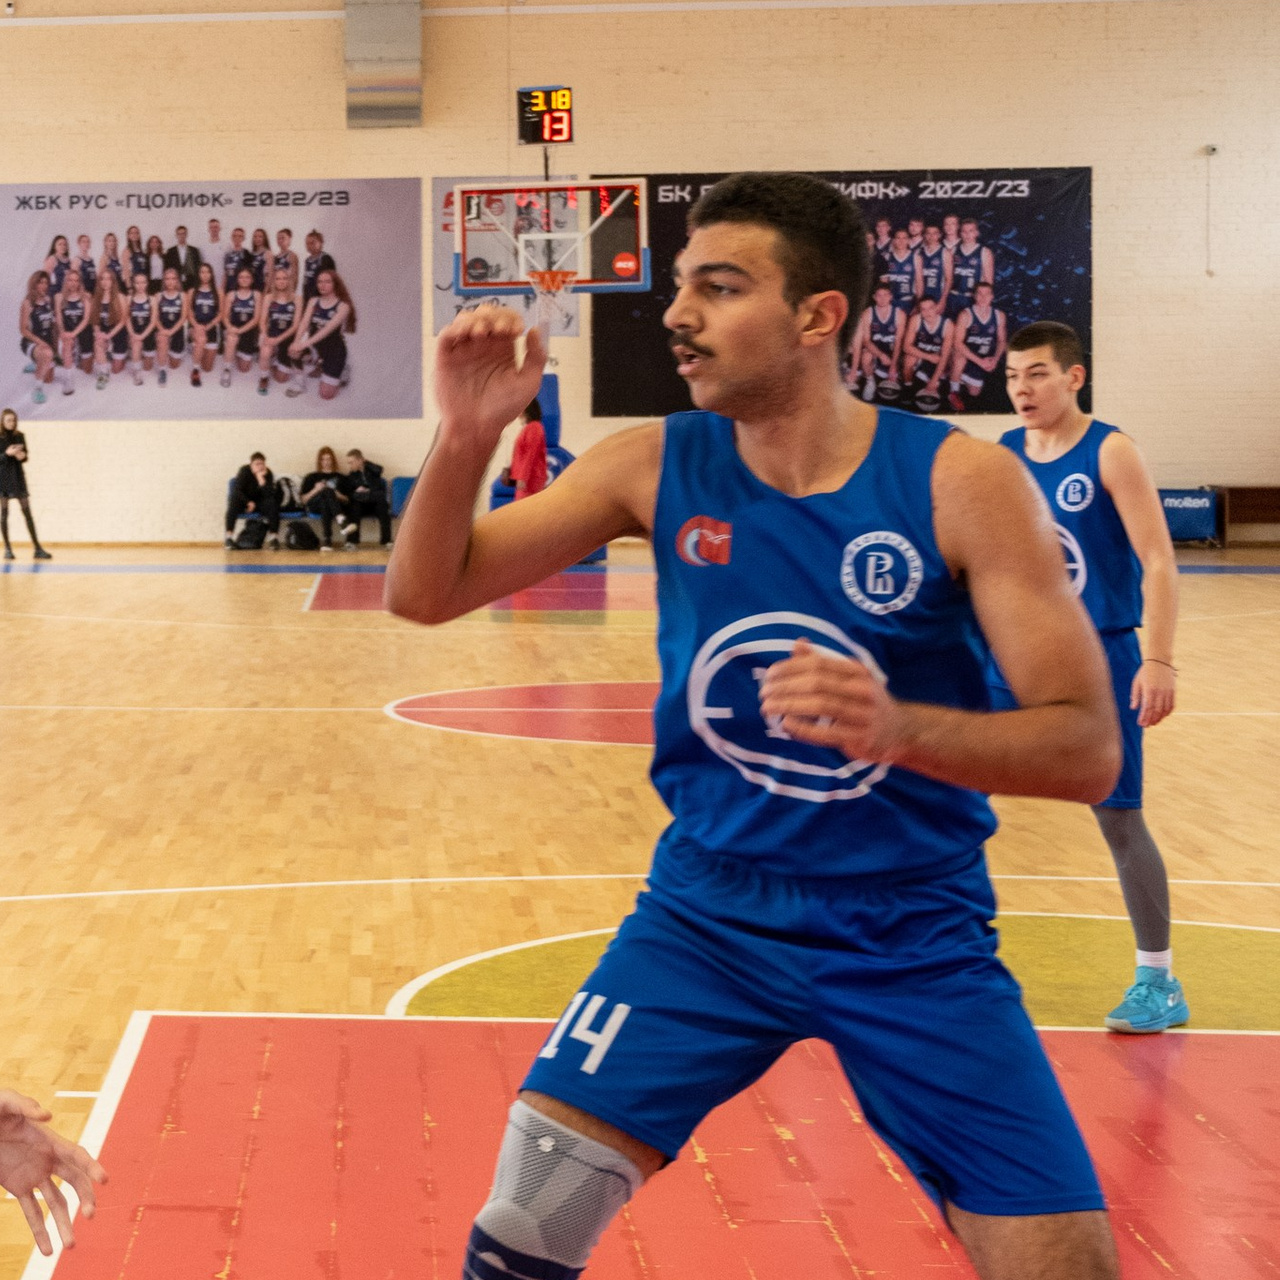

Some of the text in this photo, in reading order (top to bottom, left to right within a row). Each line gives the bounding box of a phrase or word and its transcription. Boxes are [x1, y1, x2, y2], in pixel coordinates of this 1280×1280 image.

[542, 111, 571, 141] 13
[15, 194, 61, 210] ЖБК
[69, 194, 108, 210] РУС
[242, 191, 350, 207] 2022/23
[658, 185, 692, 202] БК
[918, 179, 1030, 199] 2022/23
[537, 991, 632, 1075] 14
